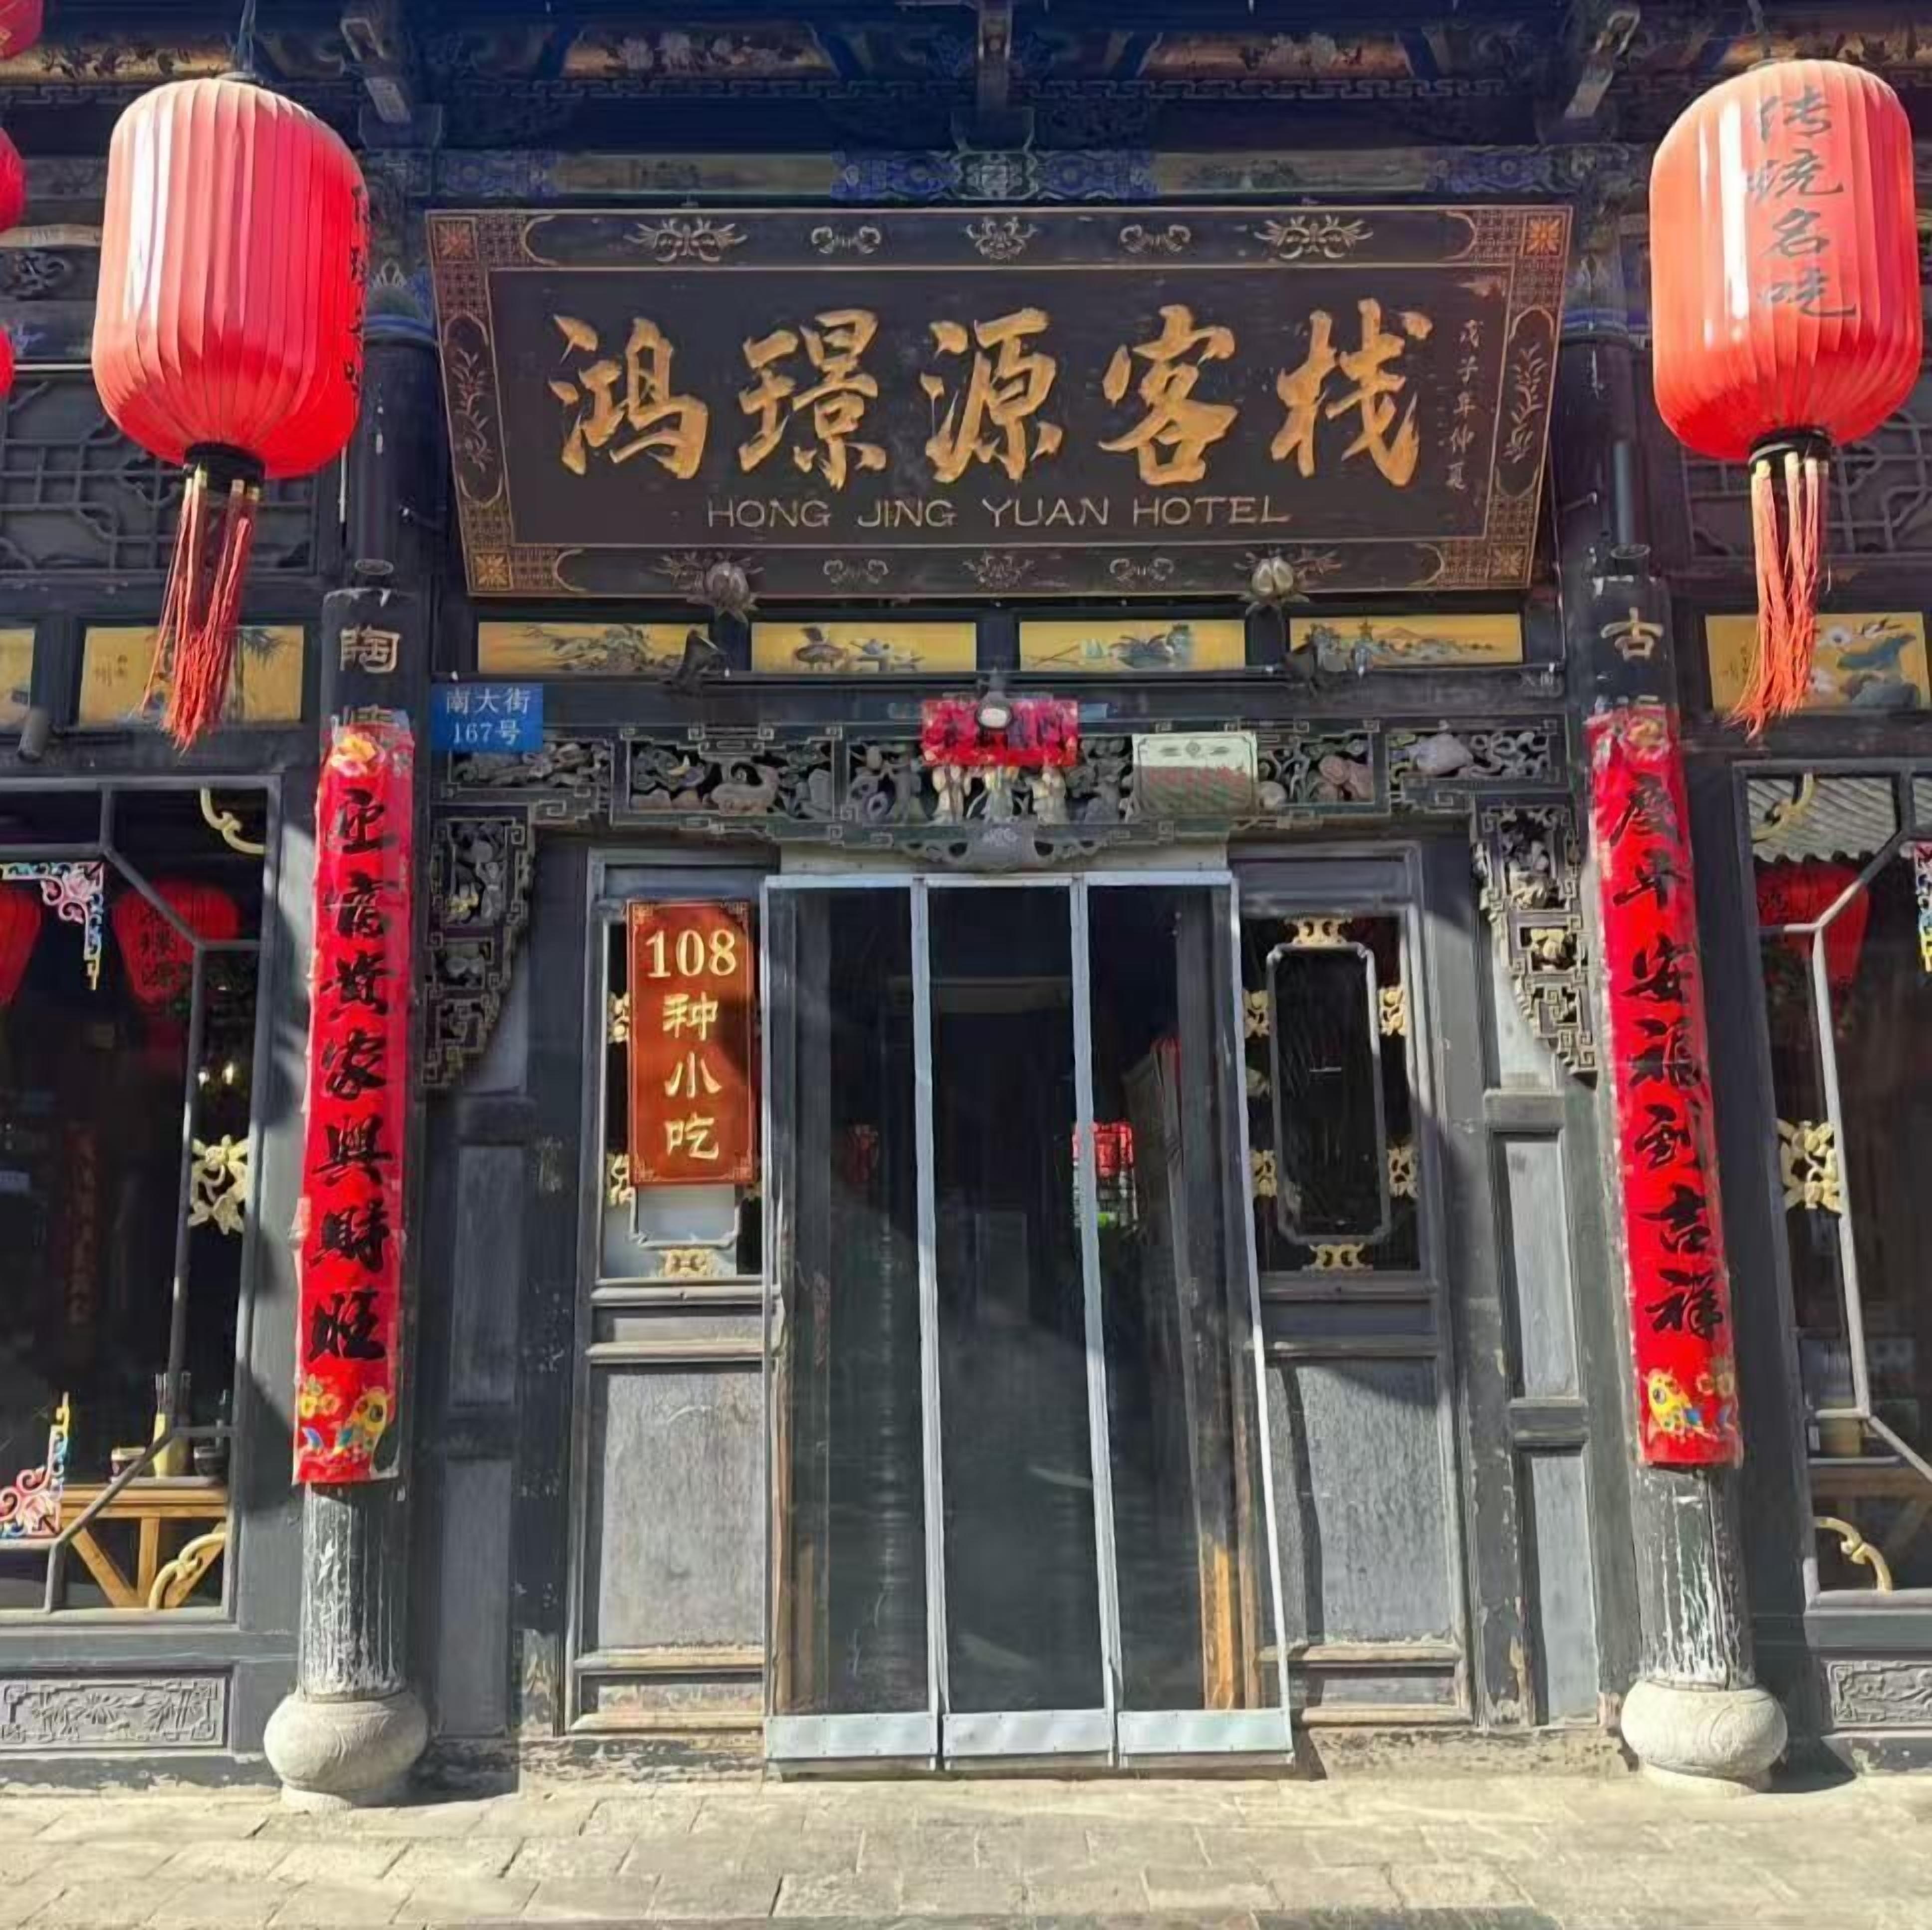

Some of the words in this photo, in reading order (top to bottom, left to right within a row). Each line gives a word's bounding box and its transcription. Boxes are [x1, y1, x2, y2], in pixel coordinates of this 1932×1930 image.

[548, 298, 1433, 491] 鸿璟源客栈
[708, 499, 831, 528] HONG
[856, 498, 957, 528] JING
[981, 498, 1108, 527] YUAN
[1132, 495, 1292, 525] HOTEL
[446, 688, 531, 715] 南大街
[453, 719, 520, 745] 167号
[645, 928, 738, 979] 108
[662, 990, 724, 1161] 种小吃
